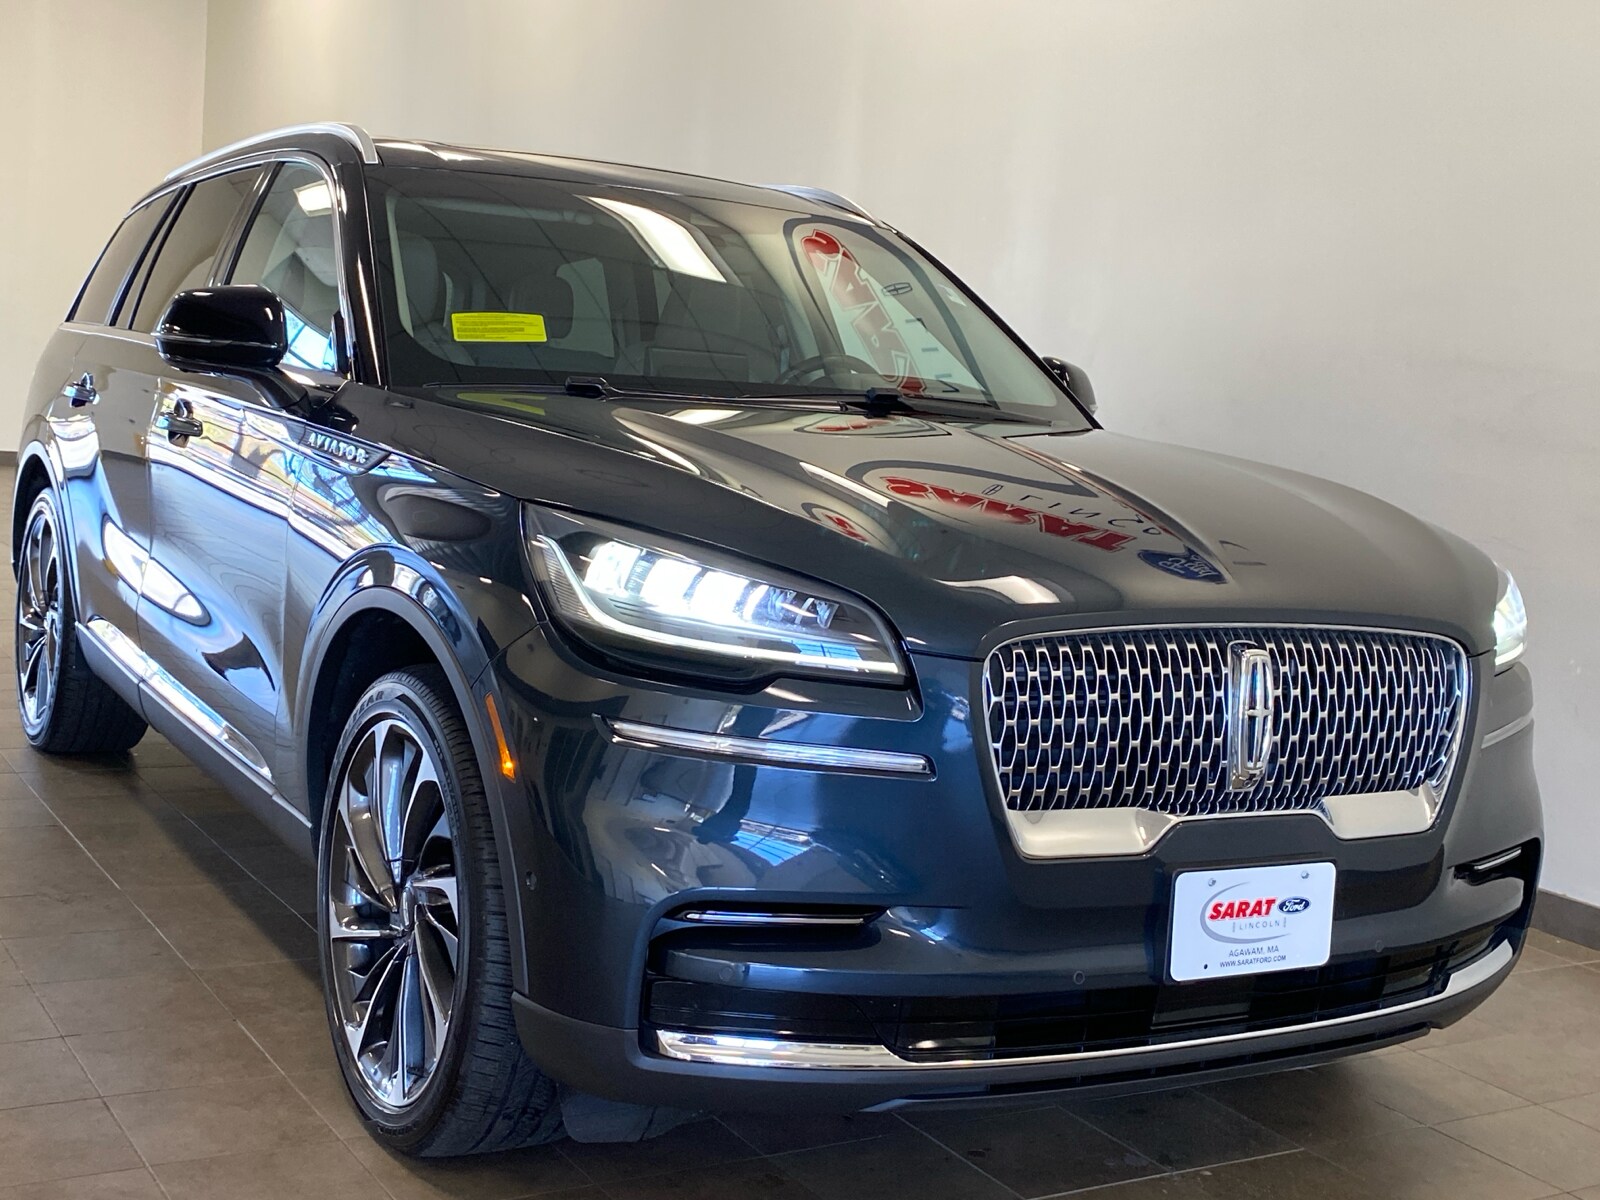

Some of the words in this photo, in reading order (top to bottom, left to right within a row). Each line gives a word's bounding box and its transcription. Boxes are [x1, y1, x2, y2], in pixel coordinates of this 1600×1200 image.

[307, 432, 369, 464] AVIATOR
[1208, 897, 1277, 921] SARAT
[1281, 898, 1308, 913] Ford
[1239, 920, 1281, 931] LINCOLN
[1267, 945, 1279, 954] MA
[1220, 955, 1287, 968] WWW.SARATFORD.COM
